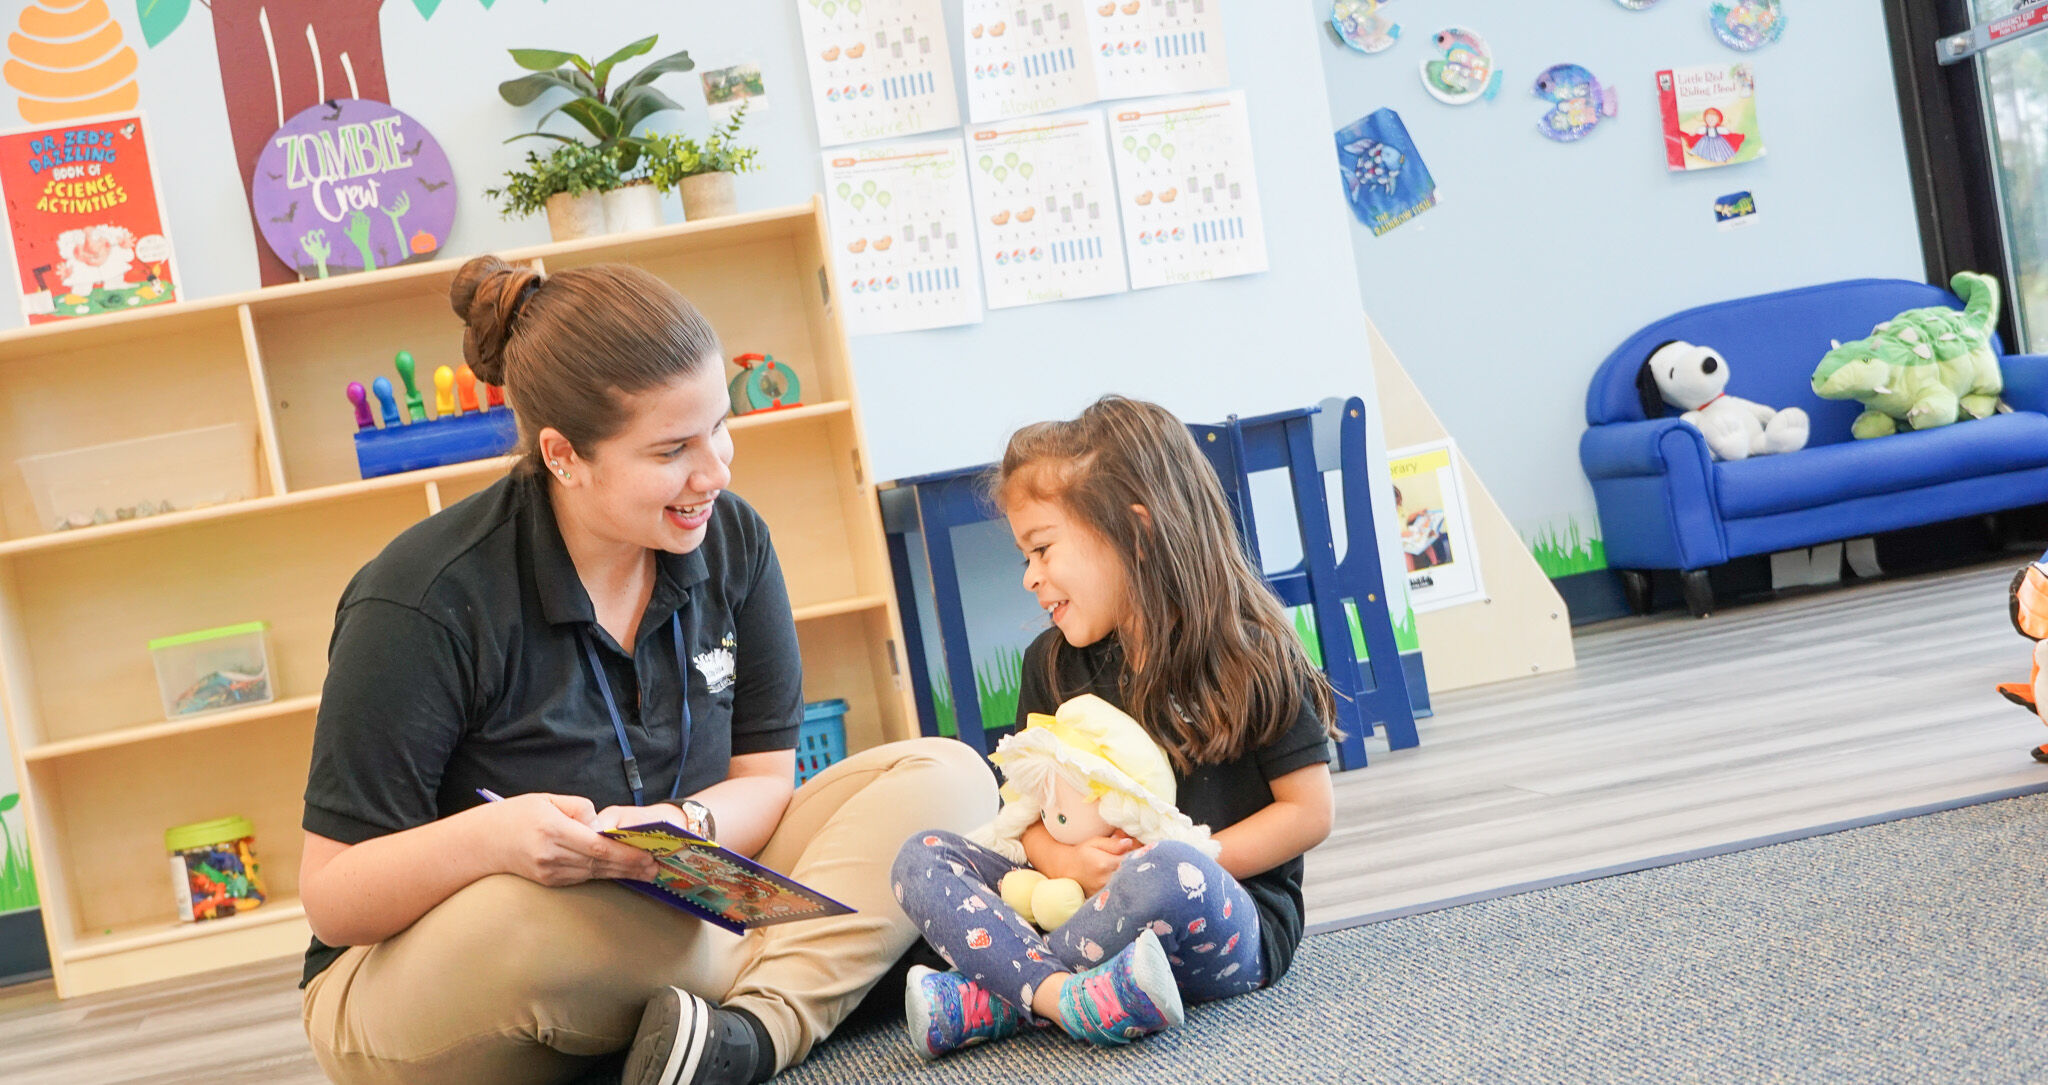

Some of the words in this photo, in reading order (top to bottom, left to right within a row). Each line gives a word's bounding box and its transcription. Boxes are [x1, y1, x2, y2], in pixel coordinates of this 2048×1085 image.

[2022, 10, 2035, 22] EXIT
[1678, 73, 1702, 84] Little
[1705, 71, 1723, 83] Red
[1680, 84, 1710, 97] Riding
[1713, 82, 1736, 95] Hood
[30, 135, 61, 155] DR.
[64, 129, 114, 147] ZED'S
[276, 115, 413, 189] ZOMBIE
[29, 146, 116, 174] DAZZLING
[52, 164, 85, 181] BOOK
[87, 163, 101, 177] OF
[44, 173, 117, 198] SCIENCE
[36, 187, 128, 214] ACTIVITIES
[312, 176, 381, 223] Crew
[1374, 211, 1411, 236] RAINBOW
[1411, 199, 1432, 216] FISH
